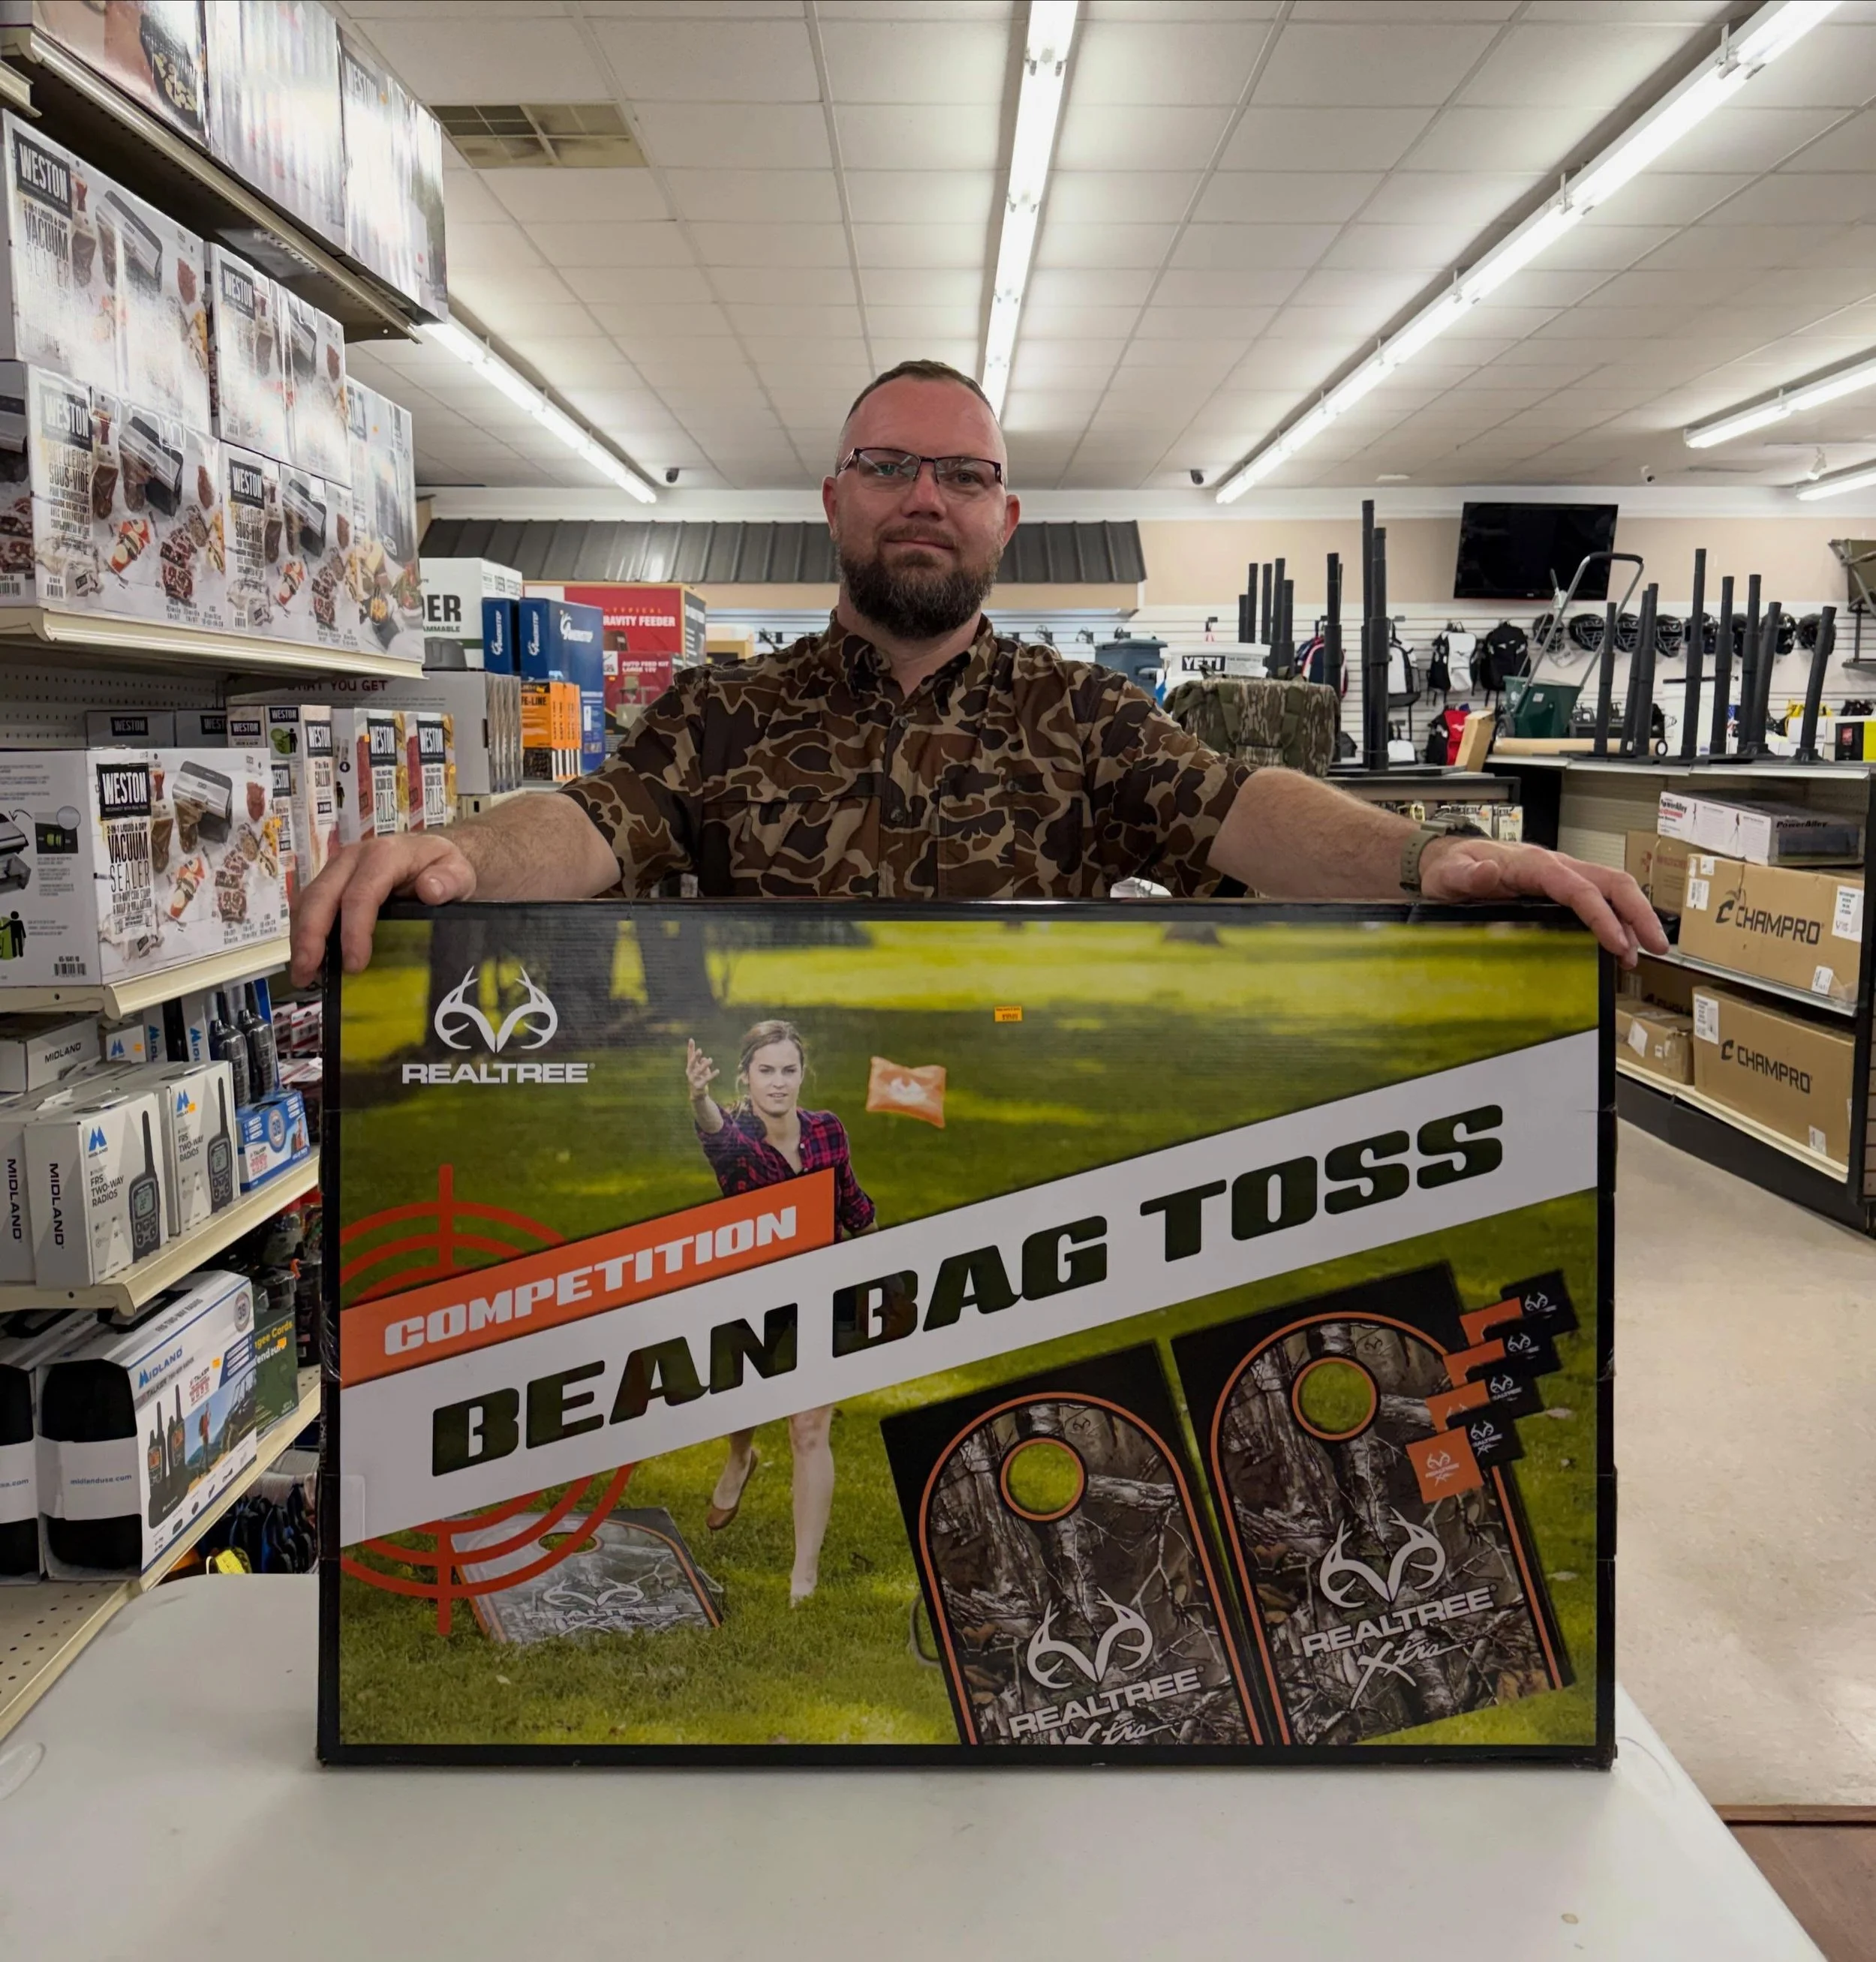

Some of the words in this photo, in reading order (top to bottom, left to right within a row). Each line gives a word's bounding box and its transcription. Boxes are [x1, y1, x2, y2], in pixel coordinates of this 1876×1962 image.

[19, 143, 68, 203] WESTON
[25, 210, 69, 262] VACUUM
[224, 269, 254, 309] WESTON
[44, 393, 89, 439] WESTON
[49, 463, 89, 494] SOUS-VIDE
[232, 465, 263, 499] WESTON
[422, 594, 462, 622] ER
[603, 615, 636, 626] RAVITY
[639, 616, 676, 627] FEEDER
[1183, 657, 1222, 670] YETI
[330, 679, 357, 691] YOU
[362, 679, 388, 691] GET
[271, 709, 297, 720] WESTON
[522, 696, 547, 706] FE-LINE
[114, 719, 146, 732] WESTON
[203, 717, 226, 730] WEST
[233, 723, 259, 734] WESTON
[307, 726, 332, 748] WESTON
[369, 726, 396, 754] WESTON
[419, 727, 445, 753] WESTON
[101, 771, 148, 805] WESTON
[107, 831, 149, 864] VACUUM
[110, 861, 150, 893] SEALER
[1735, 906, 1821, 945] CHAMPRO
[44, 1041, 82, 1063] MIDLAND
[401, 1063, 589, 1084] REALTREE
[1736, 1044, 1811, 1095] CHAMPRO
[178, 1132, 188, 1144] FRS
[178, 1134, 204, 1155] TWO-WAY
[179, 1146, 200, 1163] RADIOS
[90, 1173, 104, 1188] FRS
[90, 1174, 125, 1198] TWO-WAY
[7, 1158, 22, 1239] MIDLAND
[49, 1162, 65, 1246] MIDLAND
[92, 1188, 119, 1208] RADIOS
[383, 1206, 798, 1357] COMPETITION
[431, 1302, 798, 1477] BEAN
[831, 1215, 1108, 1357] BAG
[1139, 1104, 1503, 1263] TOSS
[271, 1320, 293, 1338] Cords
[138, 1346, 183, 1389] MIDLAND
[70, 1474, 132, 1486] midlandusa.com
[1300, 1586, 1494, 1658] REALTREE
[1351, 1639, 1473, 1710] Xtra
[1008, 1667, 1201, 1739] REALTREE
